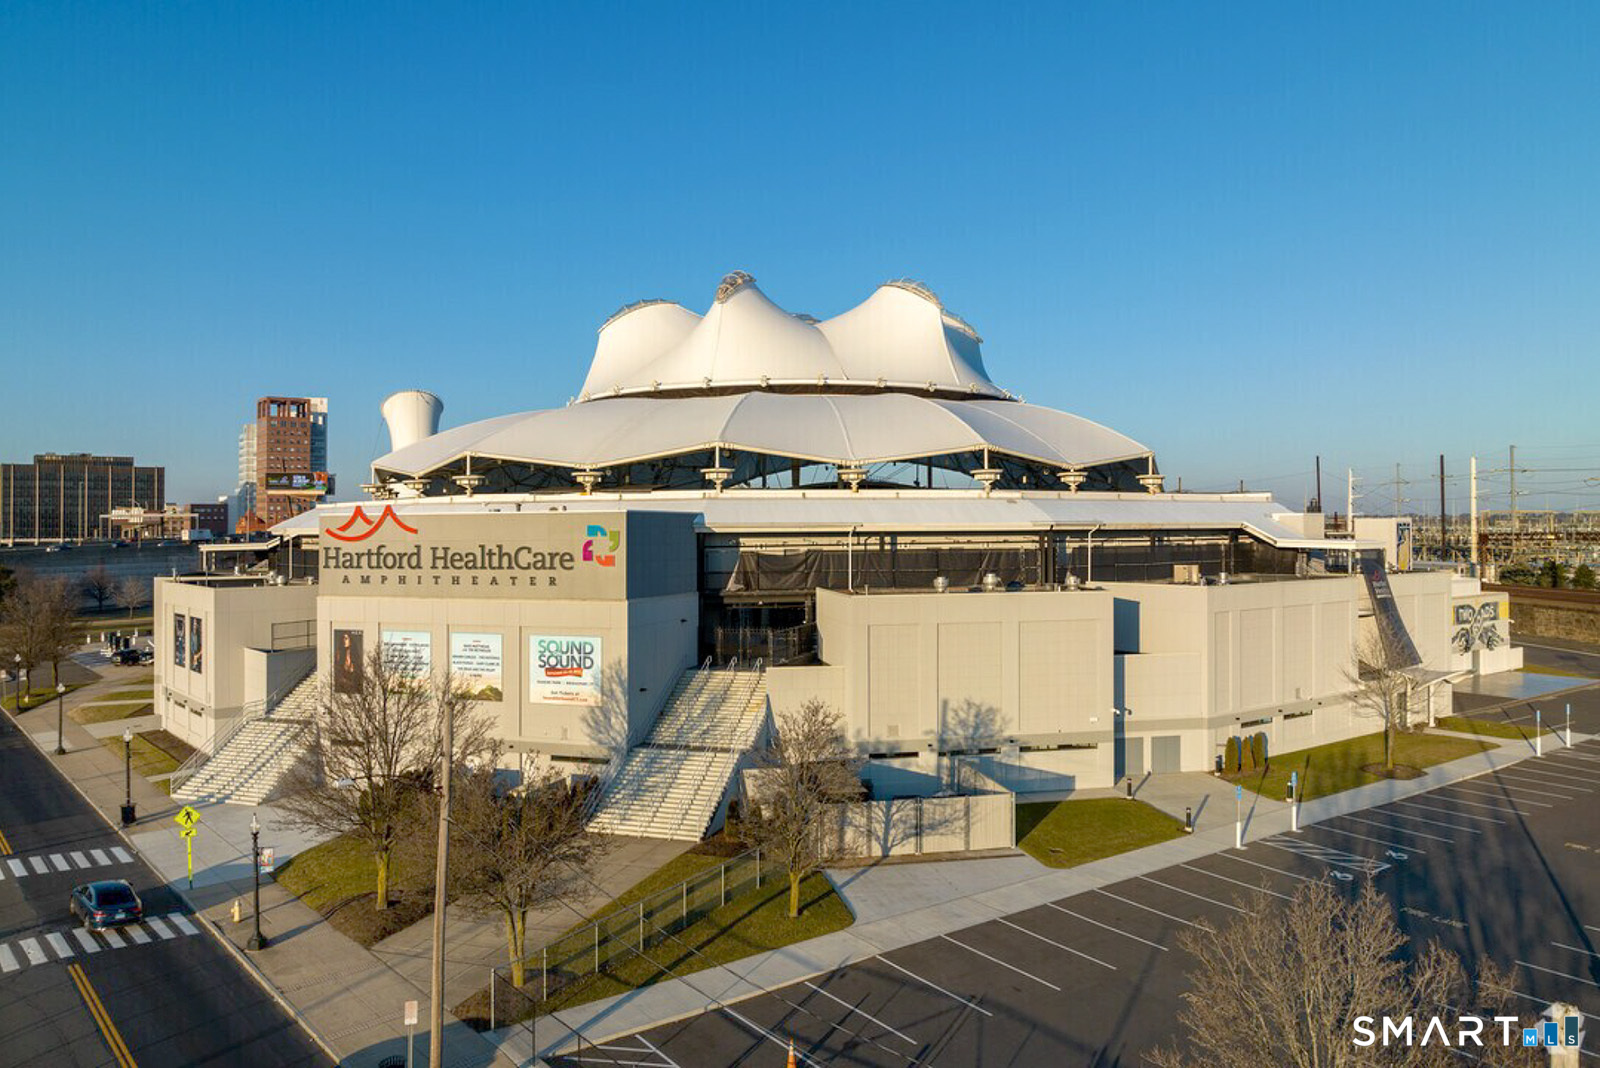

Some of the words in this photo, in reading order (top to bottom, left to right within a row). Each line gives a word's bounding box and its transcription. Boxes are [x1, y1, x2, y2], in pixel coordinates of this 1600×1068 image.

[323, 544, 423, 570] Hartford
[430, 545, 575, 571] HealthCare
[342, 575, 557, 587] AMPHITHEATER
[538, 639, 594, 655] SOUND
[538, 654, 594, 670] SOUND
